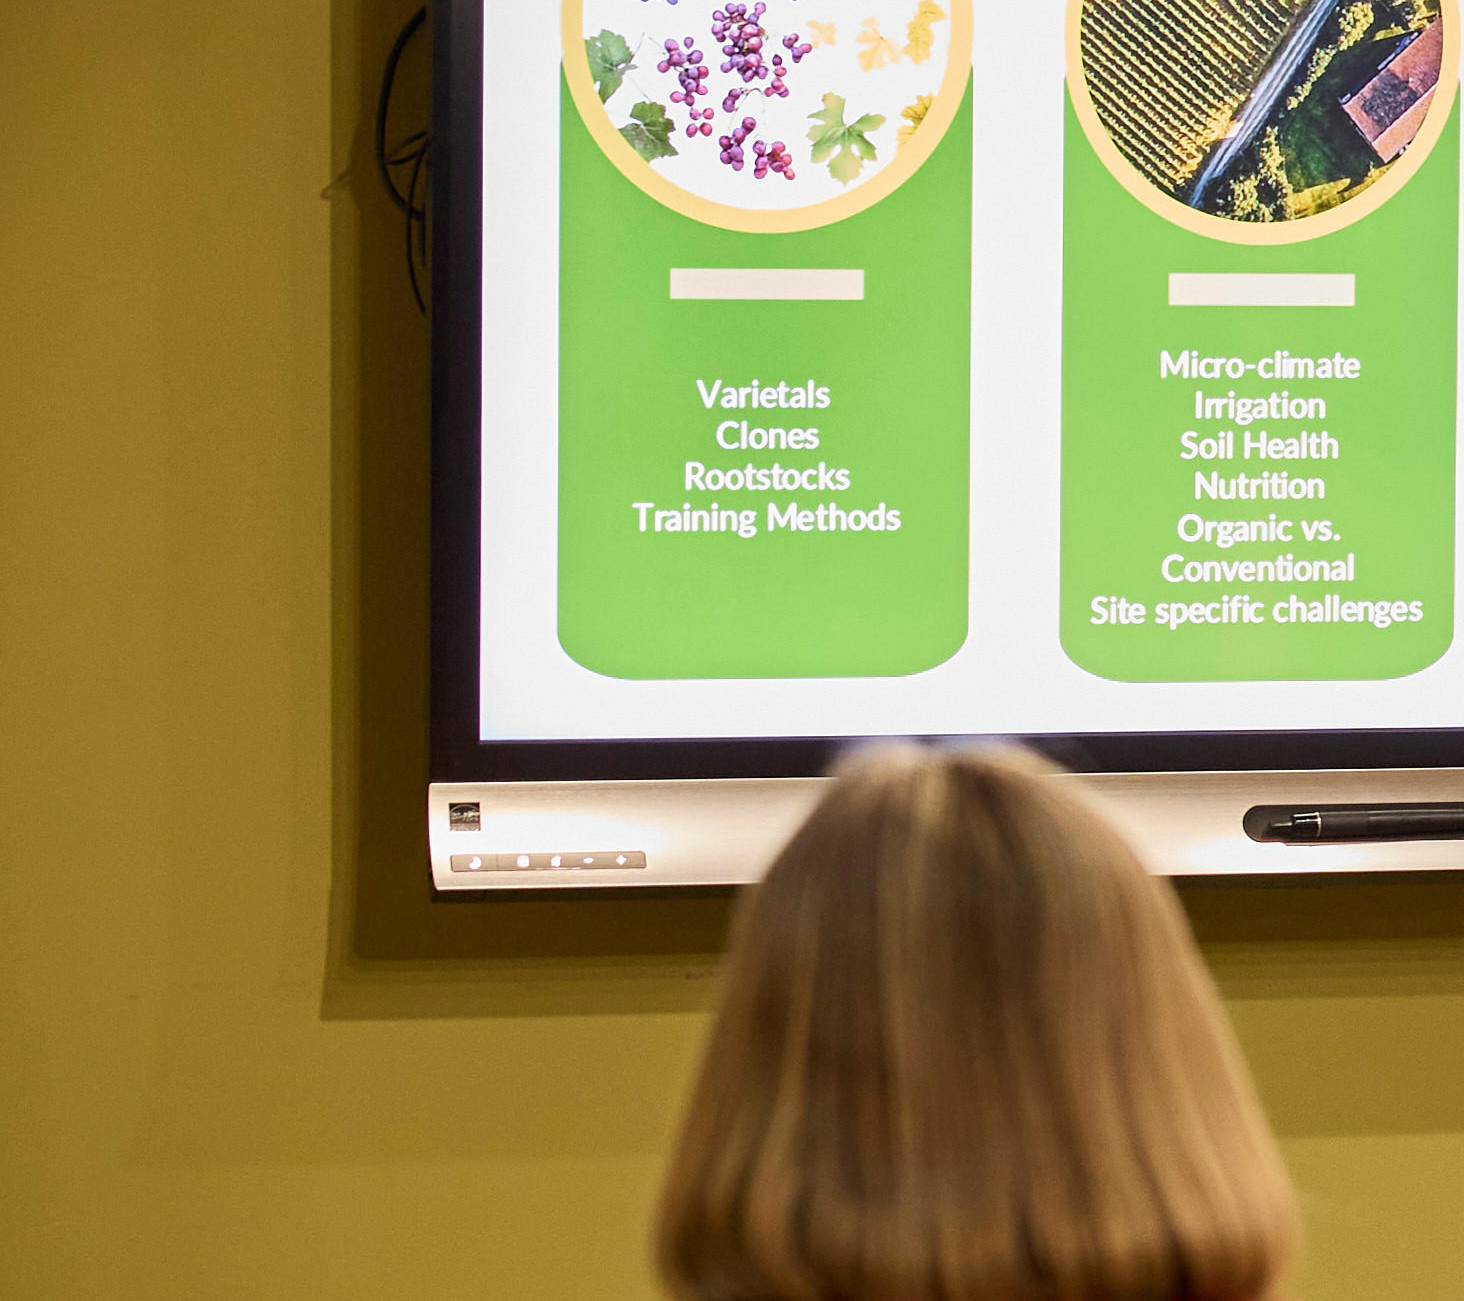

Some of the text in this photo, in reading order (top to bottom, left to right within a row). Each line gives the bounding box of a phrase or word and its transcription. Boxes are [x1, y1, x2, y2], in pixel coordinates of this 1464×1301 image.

[1161, 350, 1360, 378] Micro-climate
[696, 379, 830, 408] Varietals
[1196, 390, 1326, 425] Irrigation
[716, 421, 820, 449] Clones
[1181, 431, 1338, 459] Soil Health
[685, 462, 850, 490] Rootstocks
[1195, 471, 1325, 499] Nutrition
[632, 502, 901, 538] Training Methods
[1178, 514, 1340, 548] Organic vs.
[1162, 553, 1354, 582] Conventional
[1091, 594, 1423, 630] Site specific challenges
